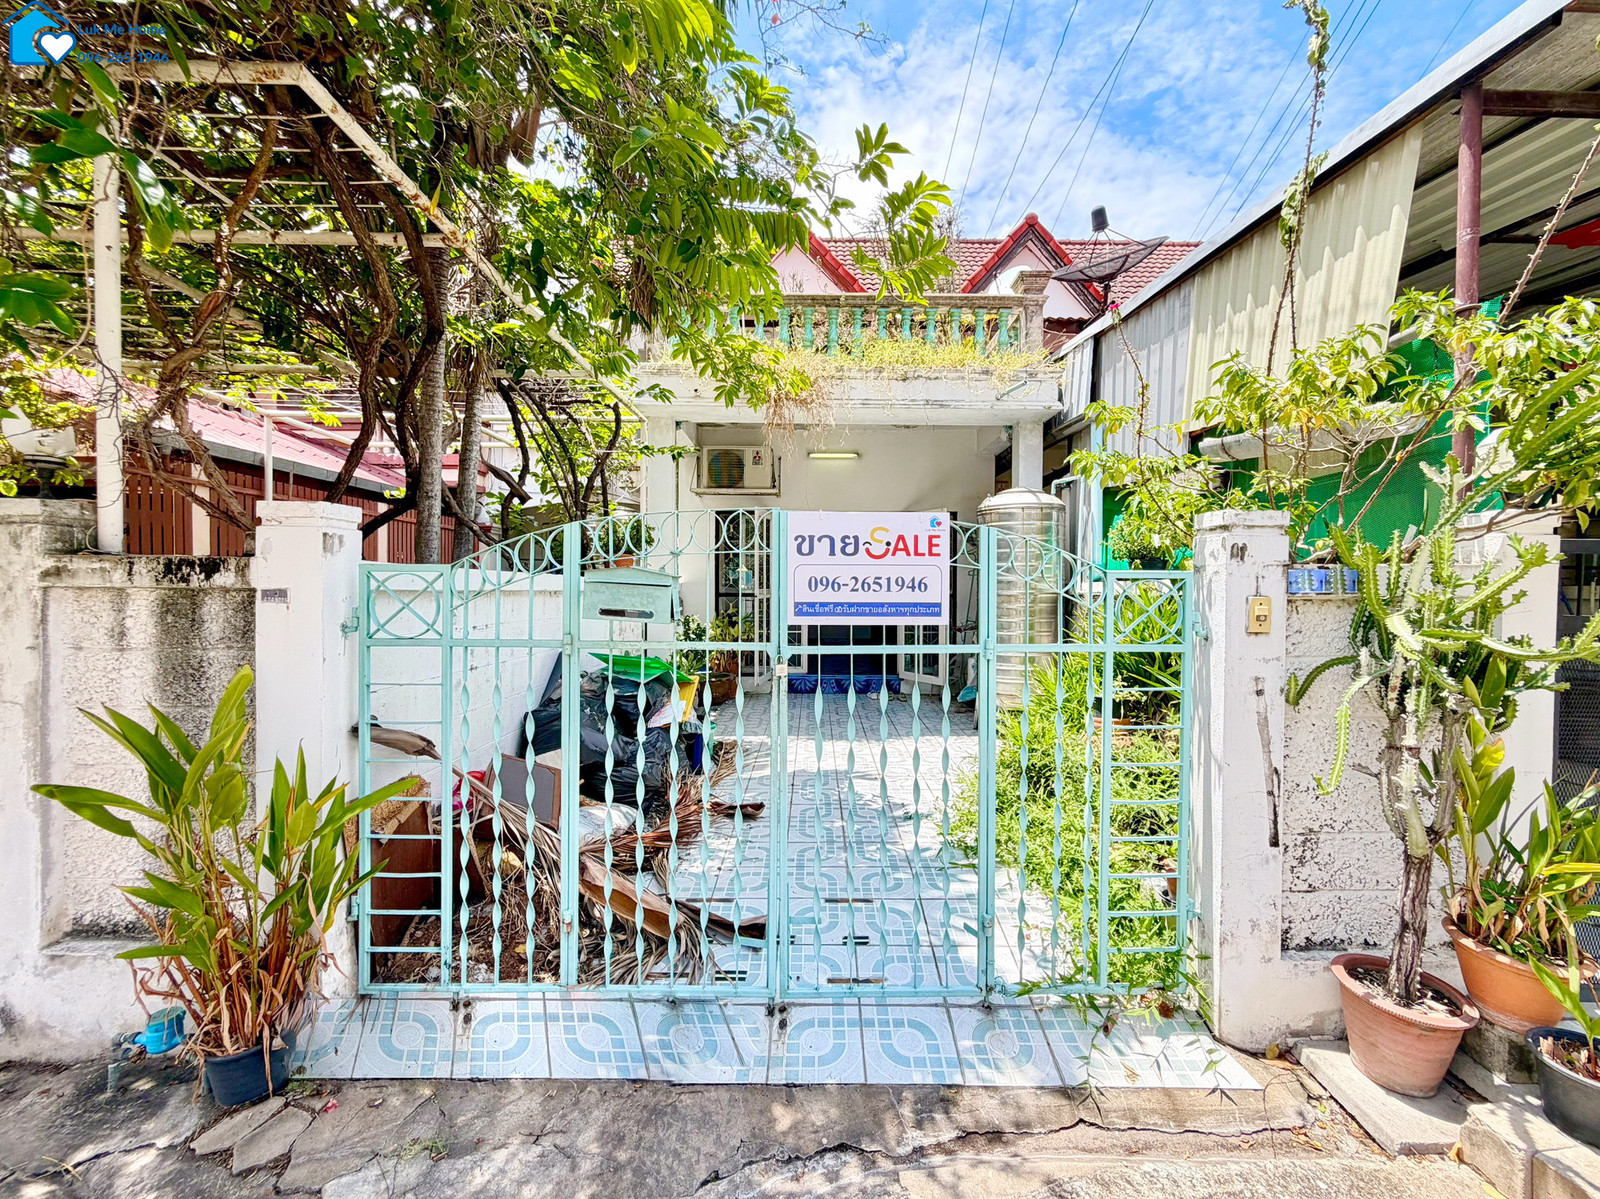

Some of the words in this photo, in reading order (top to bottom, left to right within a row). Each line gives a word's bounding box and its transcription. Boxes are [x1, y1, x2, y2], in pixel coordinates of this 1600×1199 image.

[794, 534, 859, 557] ขาย
[863, 526, 941, 560] SALE
[807, 575, 928, 593] 096-2651946
